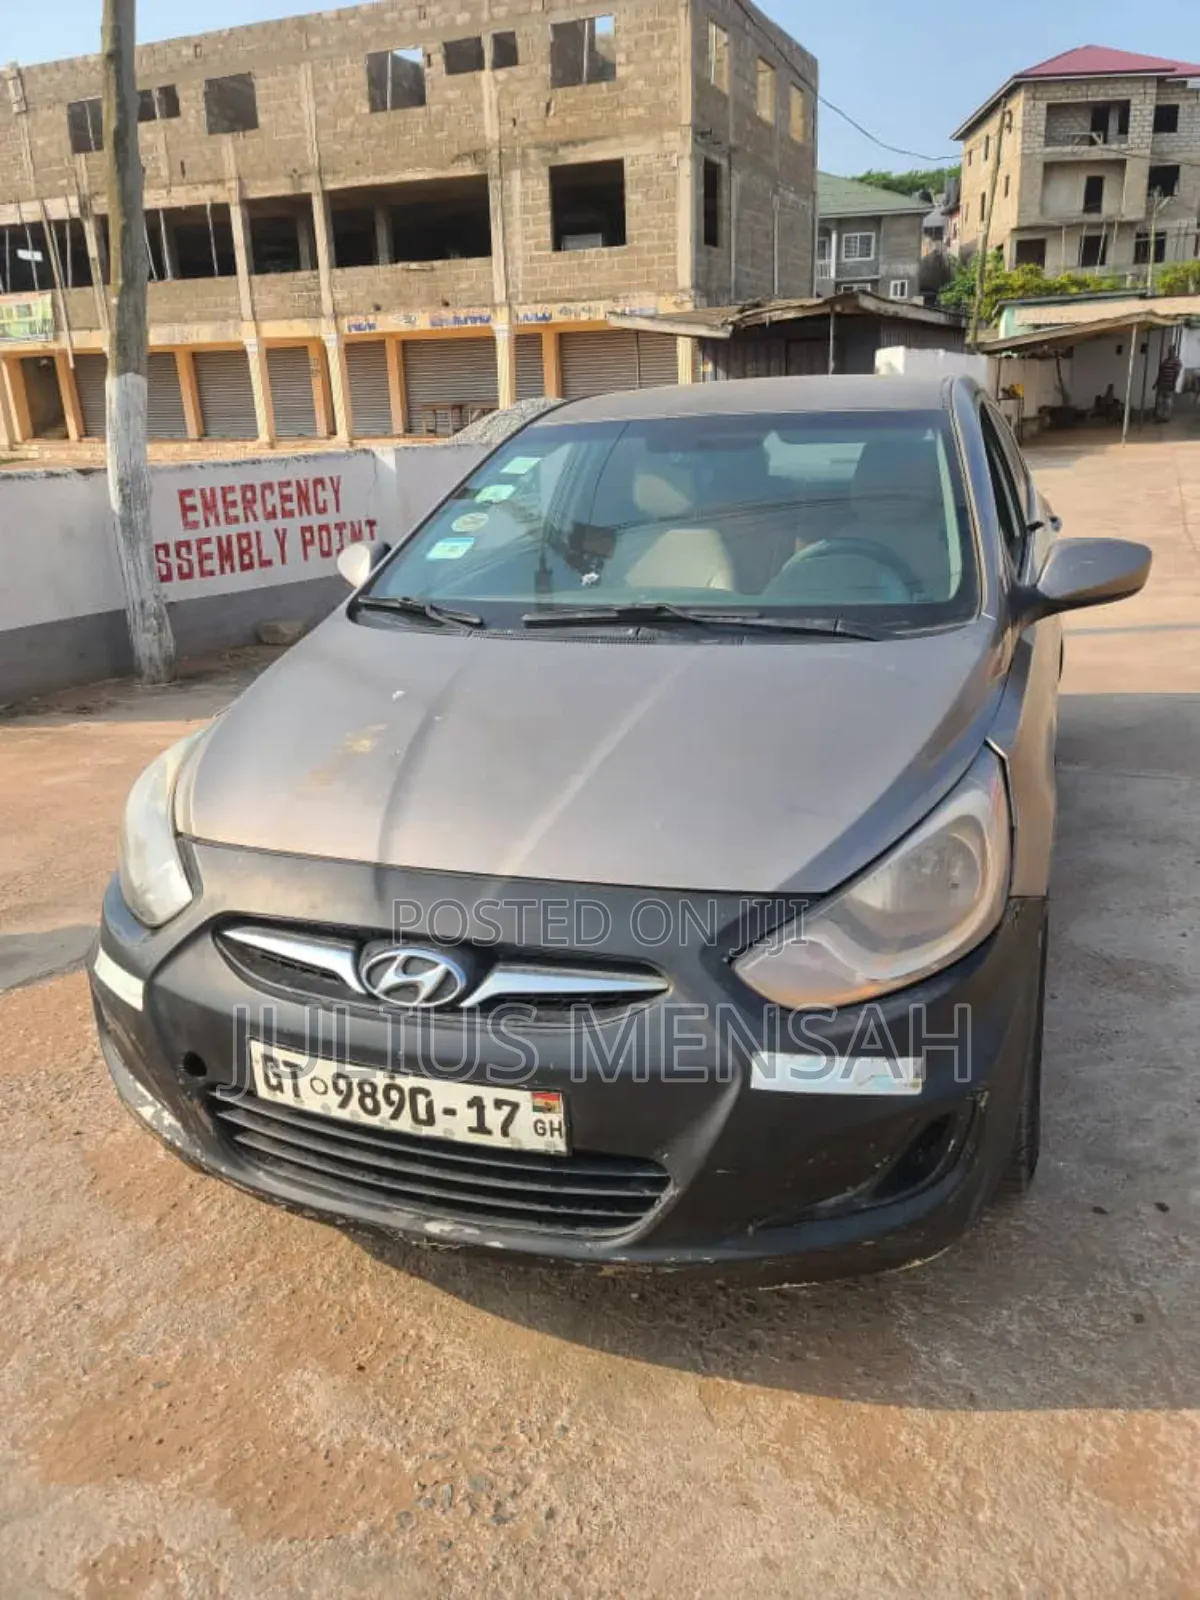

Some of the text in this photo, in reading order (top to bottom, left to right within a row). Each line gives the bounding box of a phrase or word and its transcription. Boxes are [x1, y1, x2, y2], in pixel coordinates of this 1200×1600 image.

[153, 518, 377, 583] SSEMBLY POINT
[261, 1053, 521, 1138] GT 9890-17
[532, 1118, 563, 1138] GH
